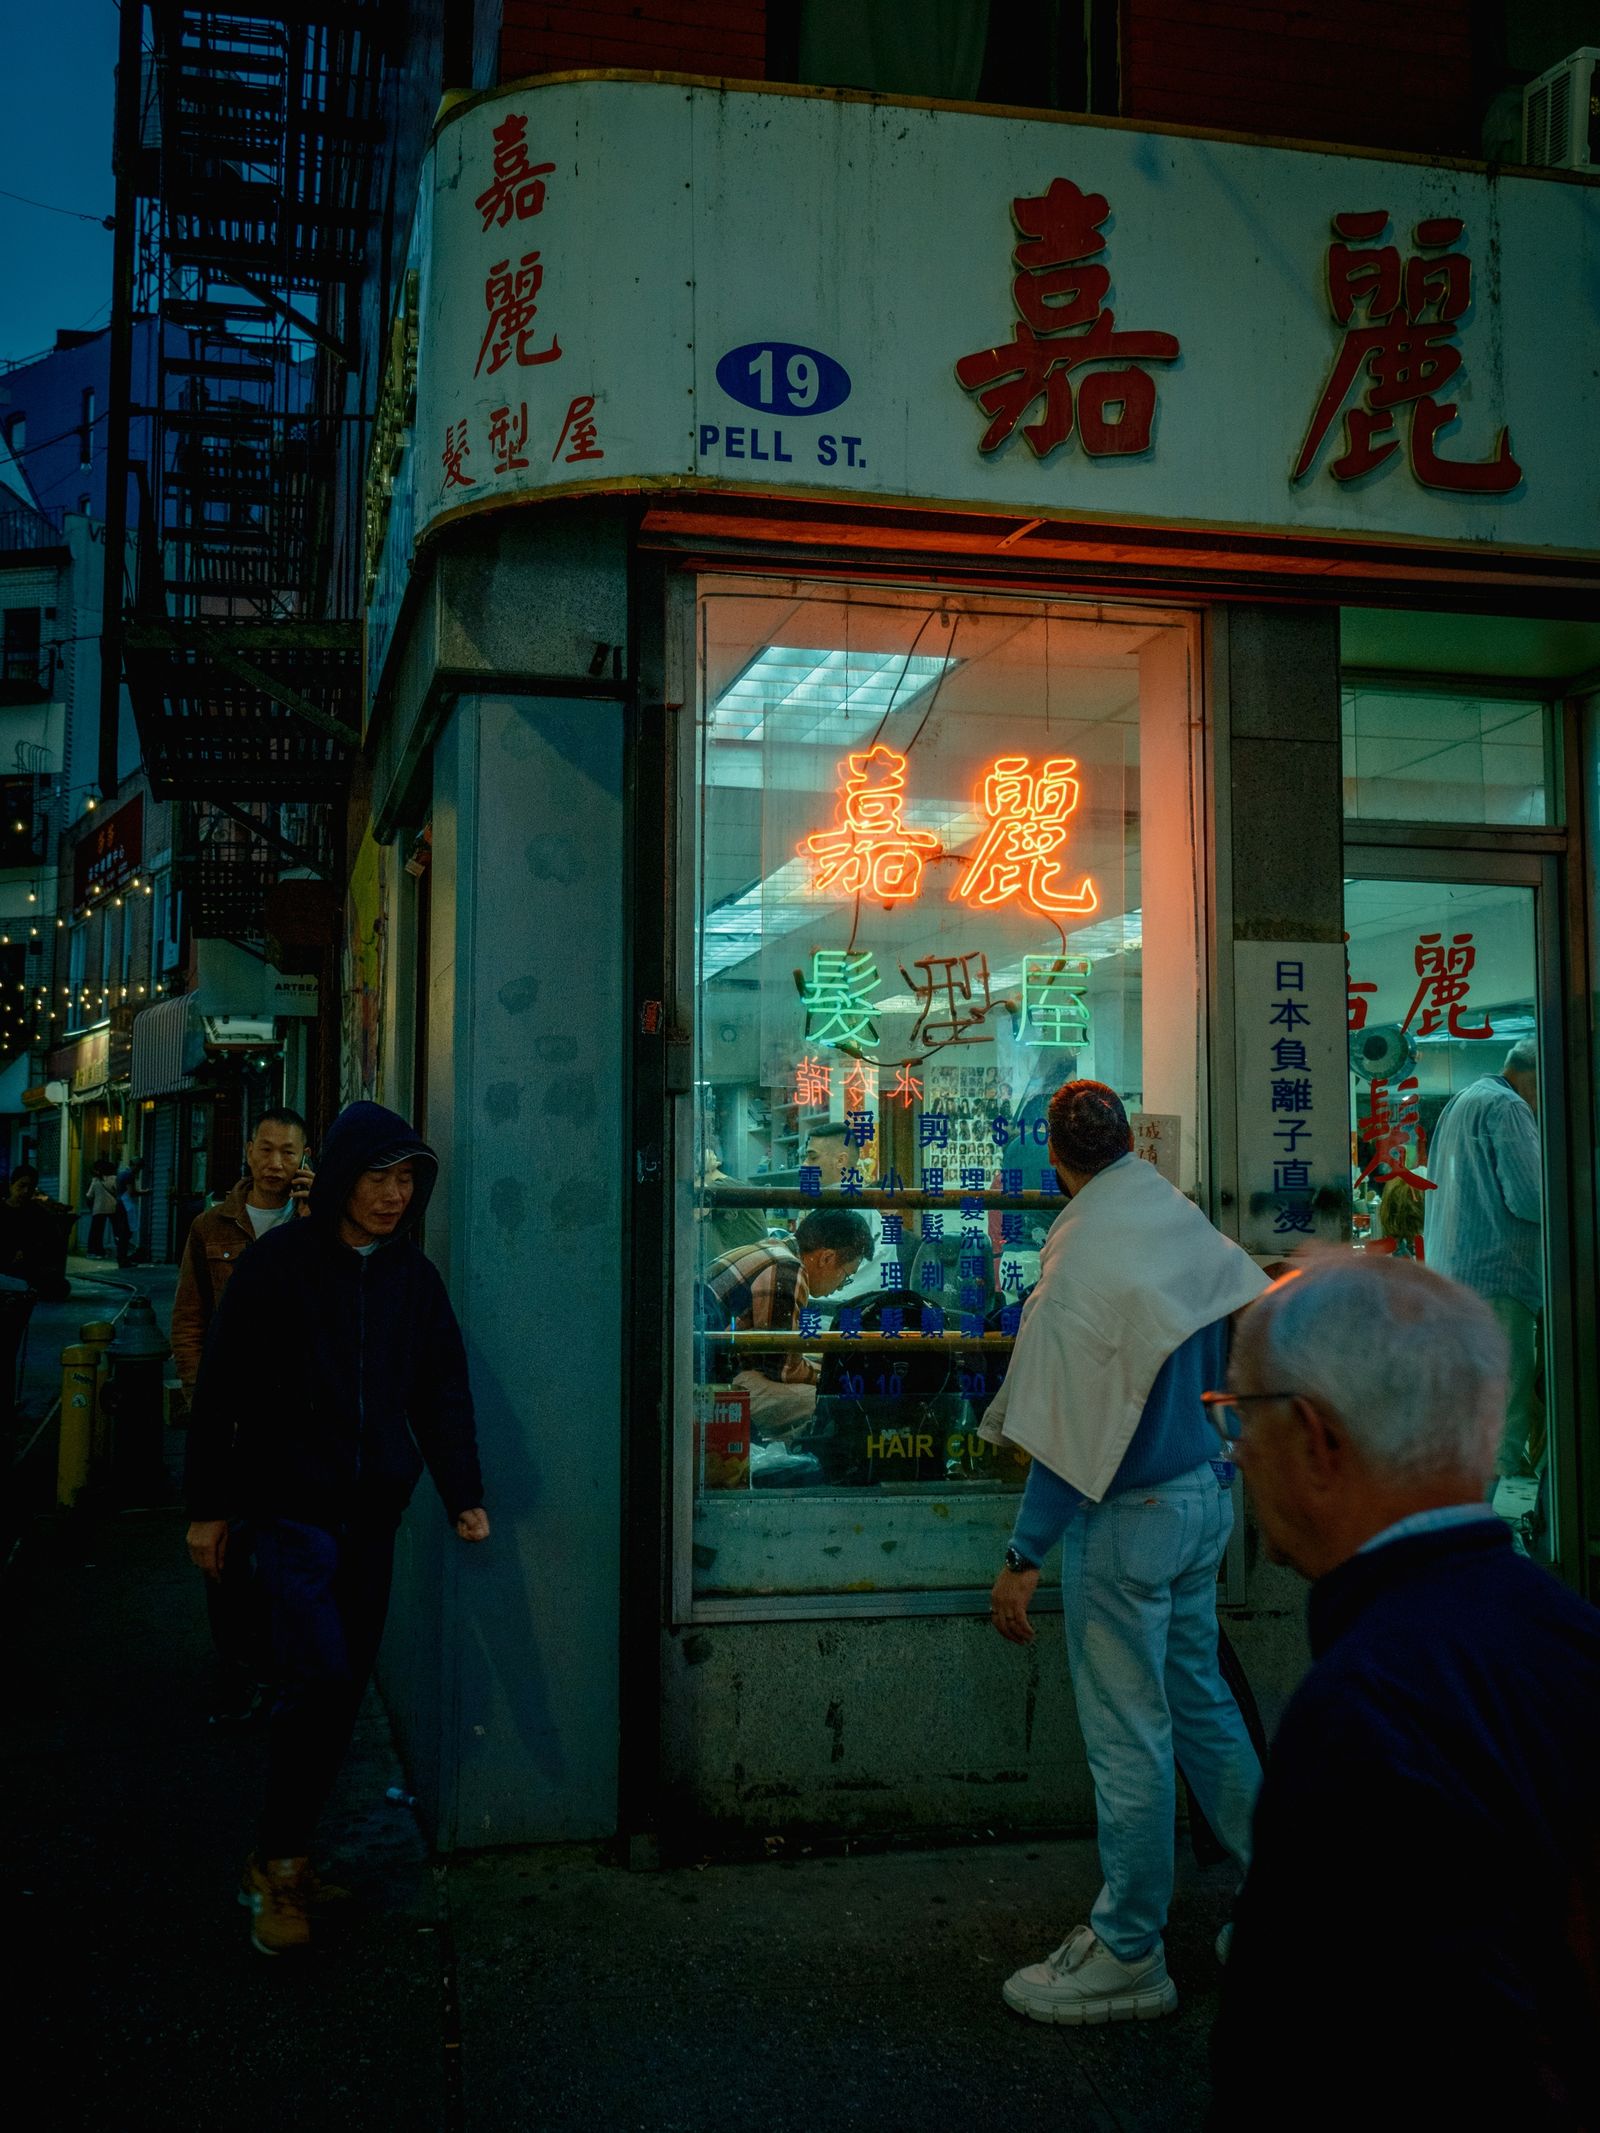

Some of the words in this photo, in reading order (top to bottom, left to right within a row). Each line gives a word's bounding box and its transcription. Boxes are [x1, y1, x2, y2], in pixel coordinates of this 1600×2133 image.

[748, 350, 820, 409] 19
[440, 396, 605, 488] 髮型屋
[700, 425, 793, 463] PELL
[817, 434, 867, 468] ST.
[992, 1114, 1050, 1147] $10
[867, 1434, 934, 1458] HAIR
